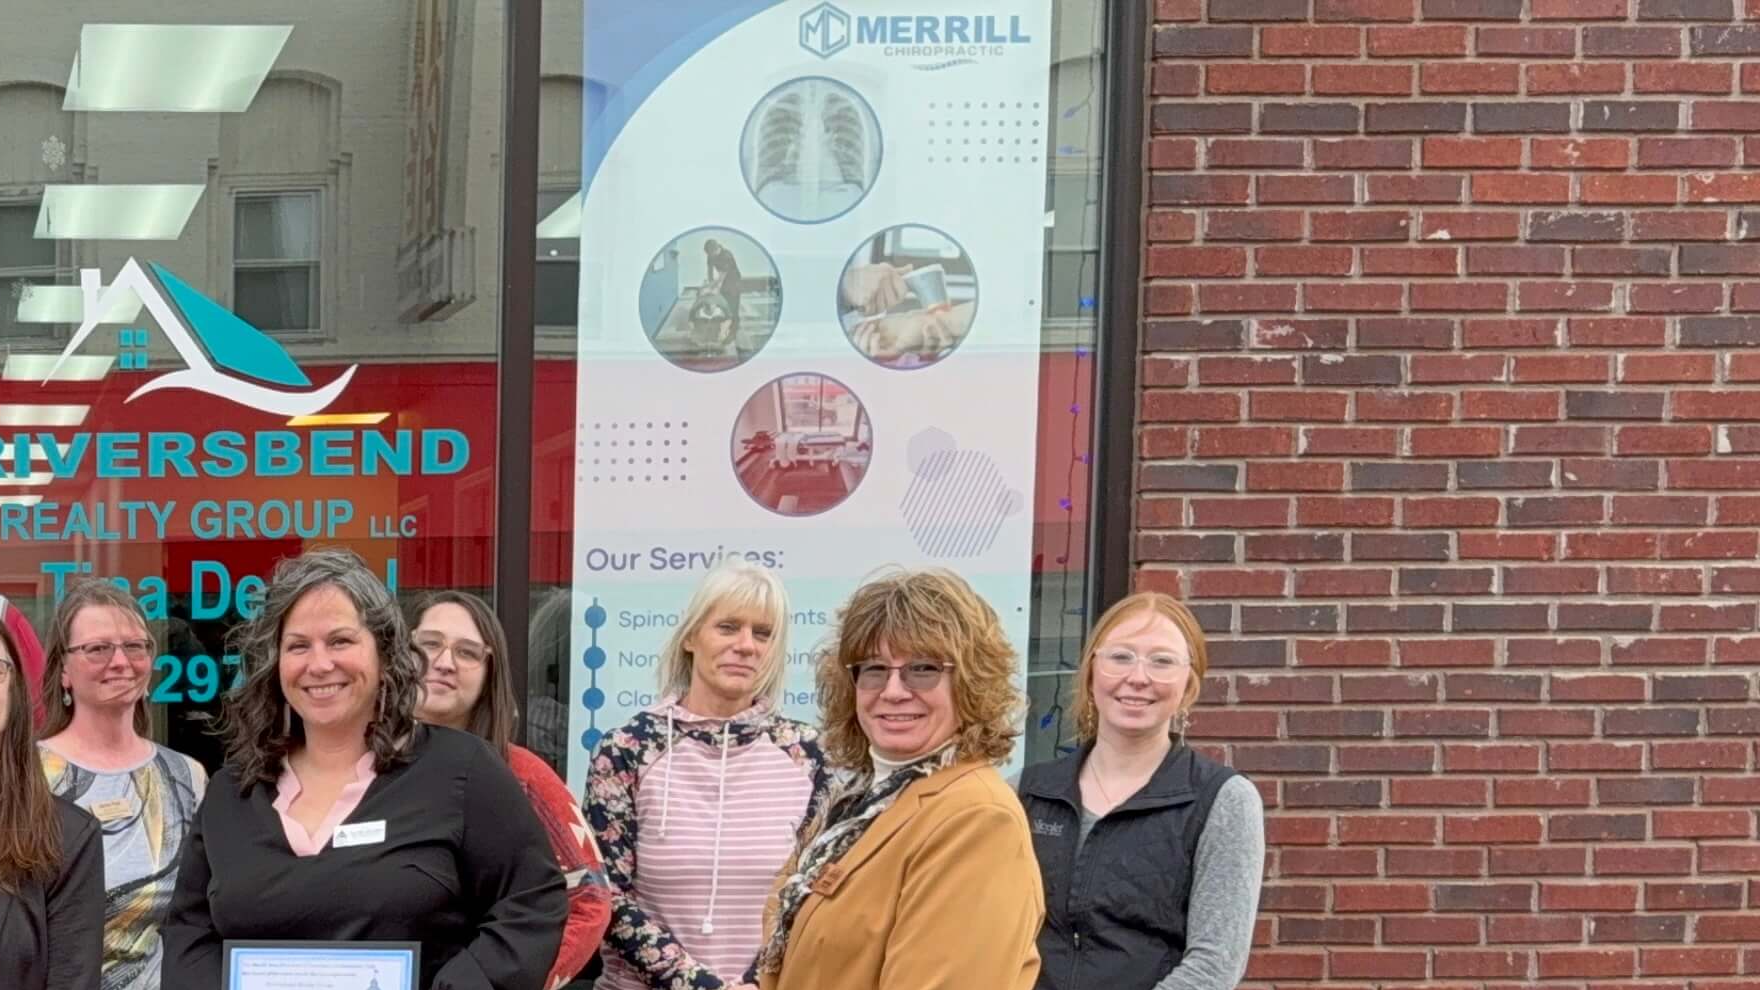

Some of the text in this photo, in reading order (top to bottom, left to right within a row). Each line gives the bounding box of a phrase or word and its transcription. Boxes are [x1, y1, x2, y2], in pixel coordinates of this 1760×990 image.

[857, 15, 1031, 44] MERRILL
[883, 45, 1004, 57] CHIROPRACTIC
[0, 499, 417, 540] REALTY GROUP LLC
[586, 548, 640, 571] Our
[619, 609, 684, 631] Spina
